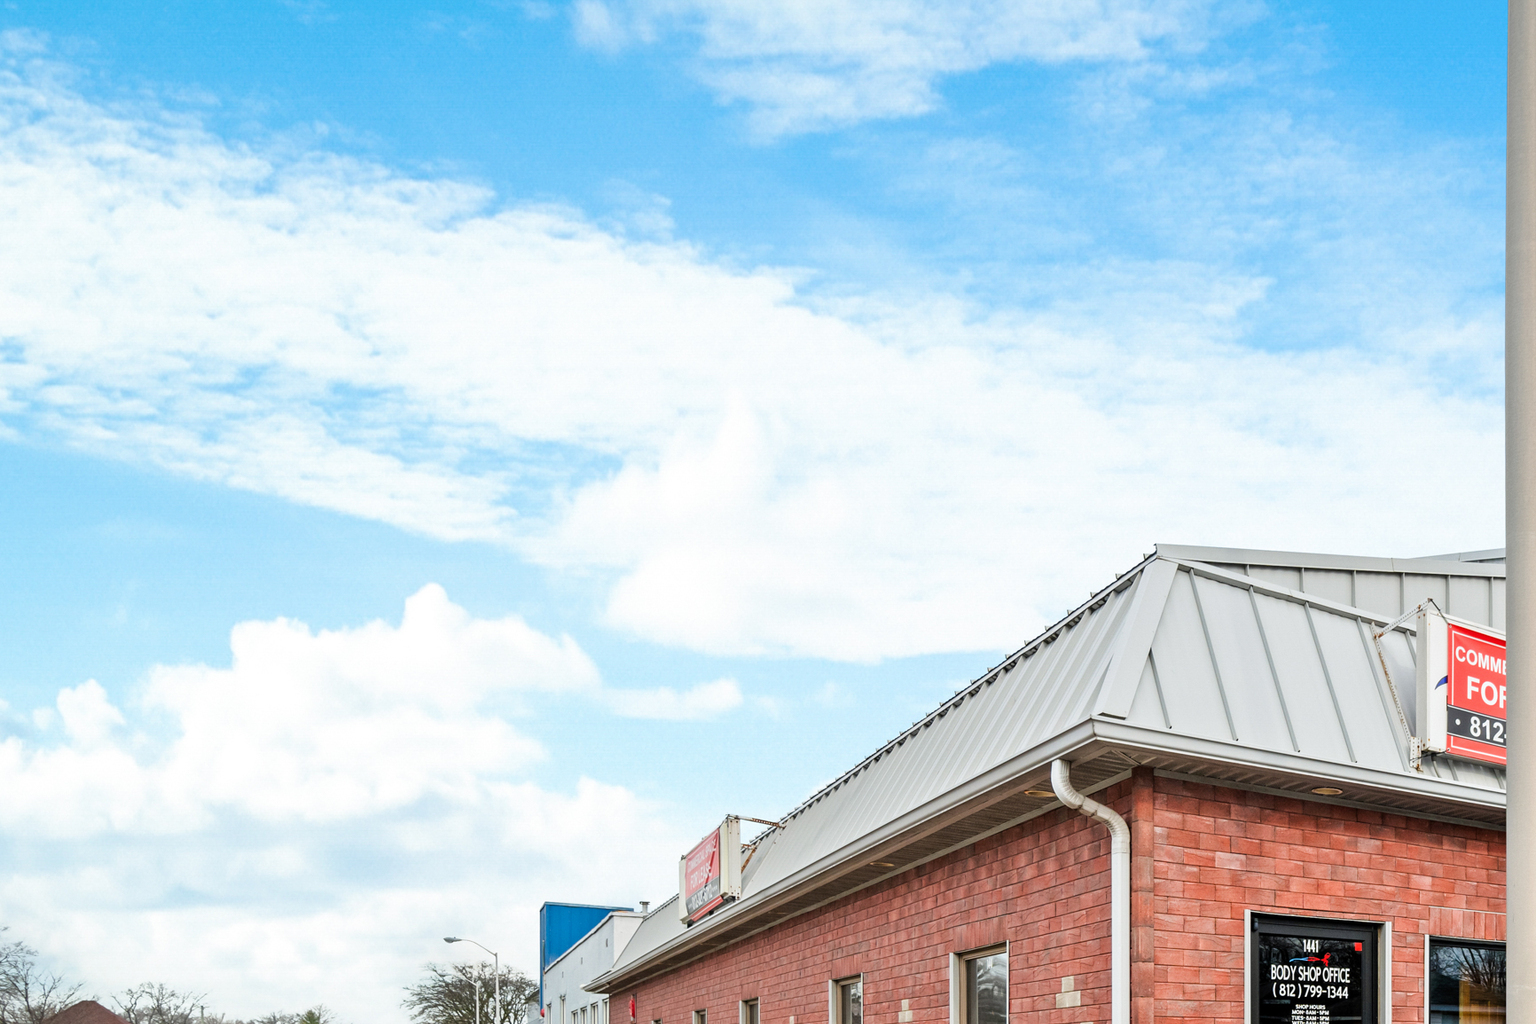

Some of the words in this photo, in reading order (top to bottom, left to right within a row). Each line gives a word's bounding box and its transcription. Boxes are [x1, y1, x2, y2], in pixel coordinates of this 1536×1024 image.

[1303, 939, 1319, 953] 1441
[1271, 964, 1296, 980] BODY
[1298, 966, 1322, 982] SHOP
[1322, 967, 1350, 983] OFFICE
[1303, 984, 1349, 999] 799-1344
